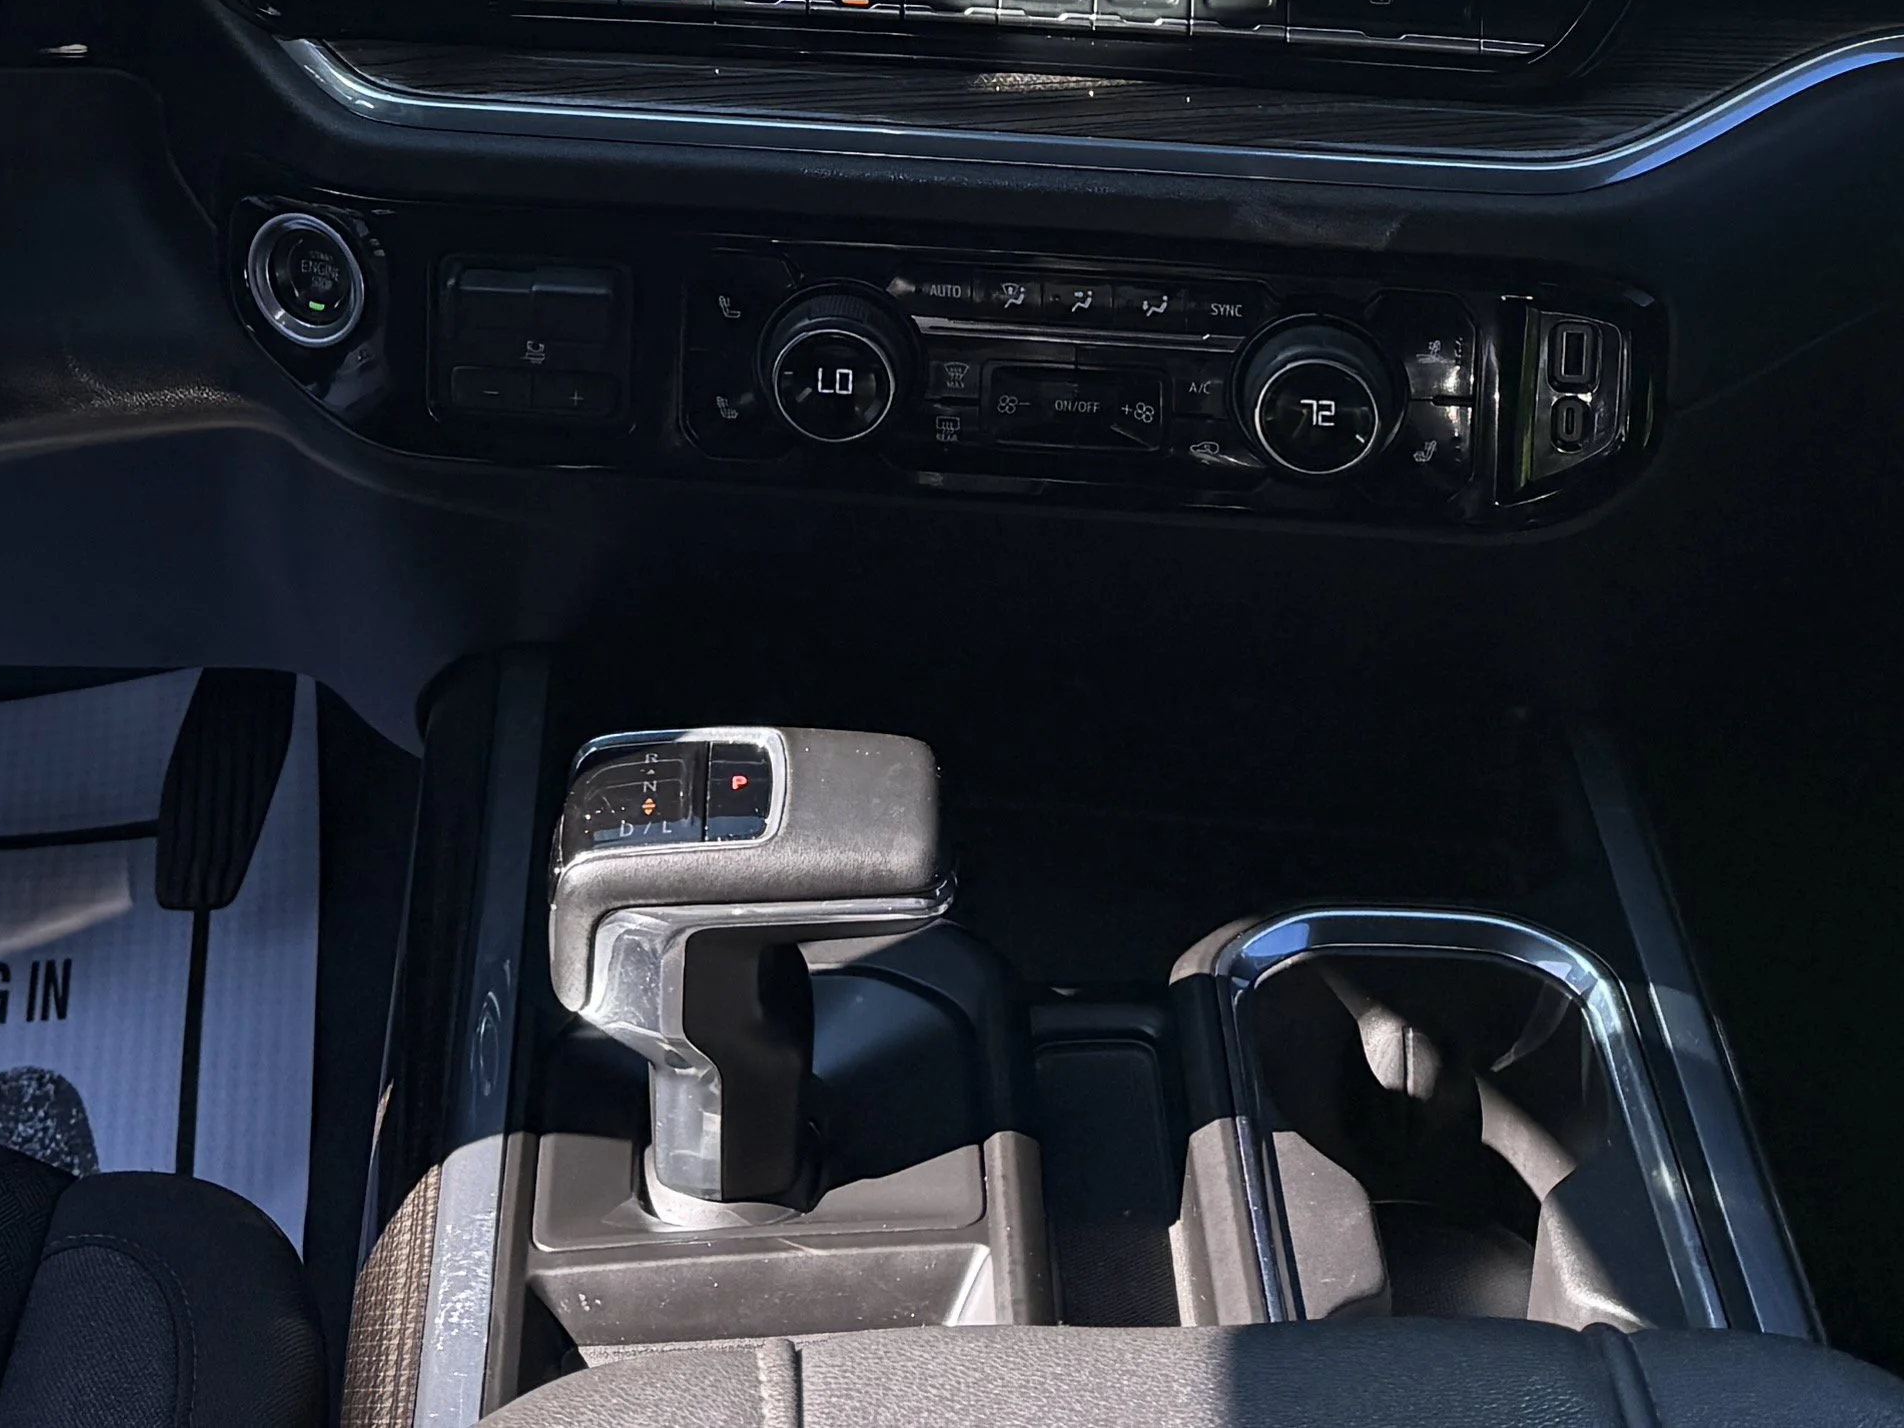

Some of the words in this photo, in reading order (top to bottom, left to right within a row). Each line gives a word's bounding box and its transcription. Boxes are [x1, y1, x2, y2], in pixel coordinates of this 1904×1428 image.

[300, 259, 340, 282] ENGINE
[930, 284, 962, 299] AUTO
[1210, 300, 1244, 317] SYNC
[817, 367, 854, 395] LO
[1189, 380, 1211, 394] A/C
[1054, 398, 1101, 415] ON/OFF
[1299, 398, 1336, 428] 72
[644, 753, 659, 764] R
[642, 780, 658, 792] N
[732, 775, 749, 790] P
[619, 822, 635, 837] D
[662, 820, 674, 834] L
[24, 956, 73, 1022] IN
